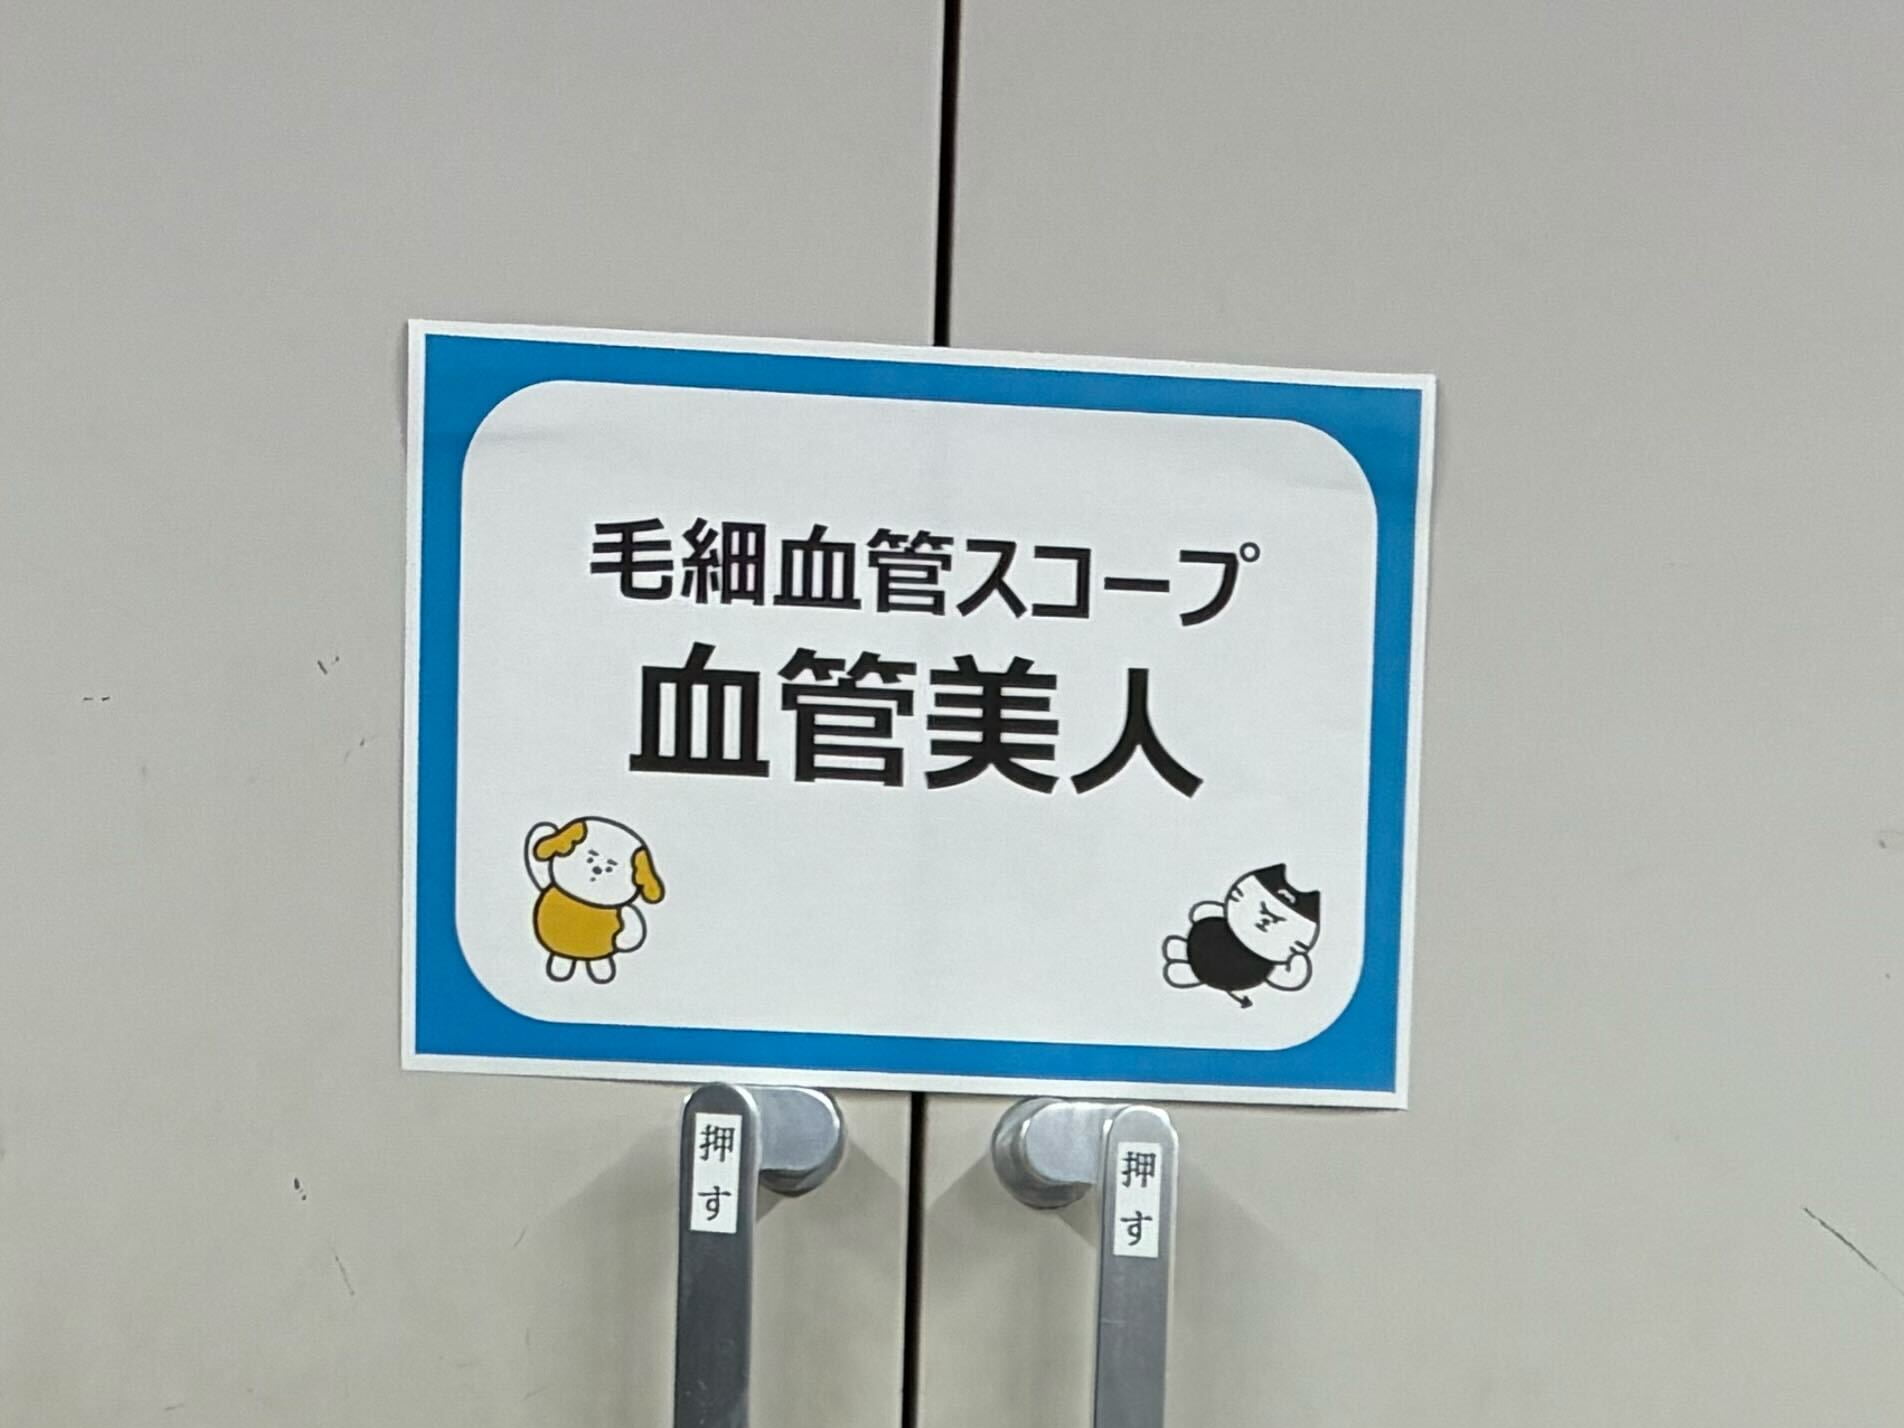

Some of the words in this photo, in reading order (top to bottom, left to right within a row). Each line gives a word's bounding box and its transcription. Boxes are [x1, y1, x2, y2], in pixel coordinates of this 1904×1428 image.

[588, 516, 1262, 627] 毛細血管スコープ
[629, 642, 1204, 800] 血管美人
[698, 1124, 736, 1222] 押す
[1119, 1150, 1157, 1246] 押す
